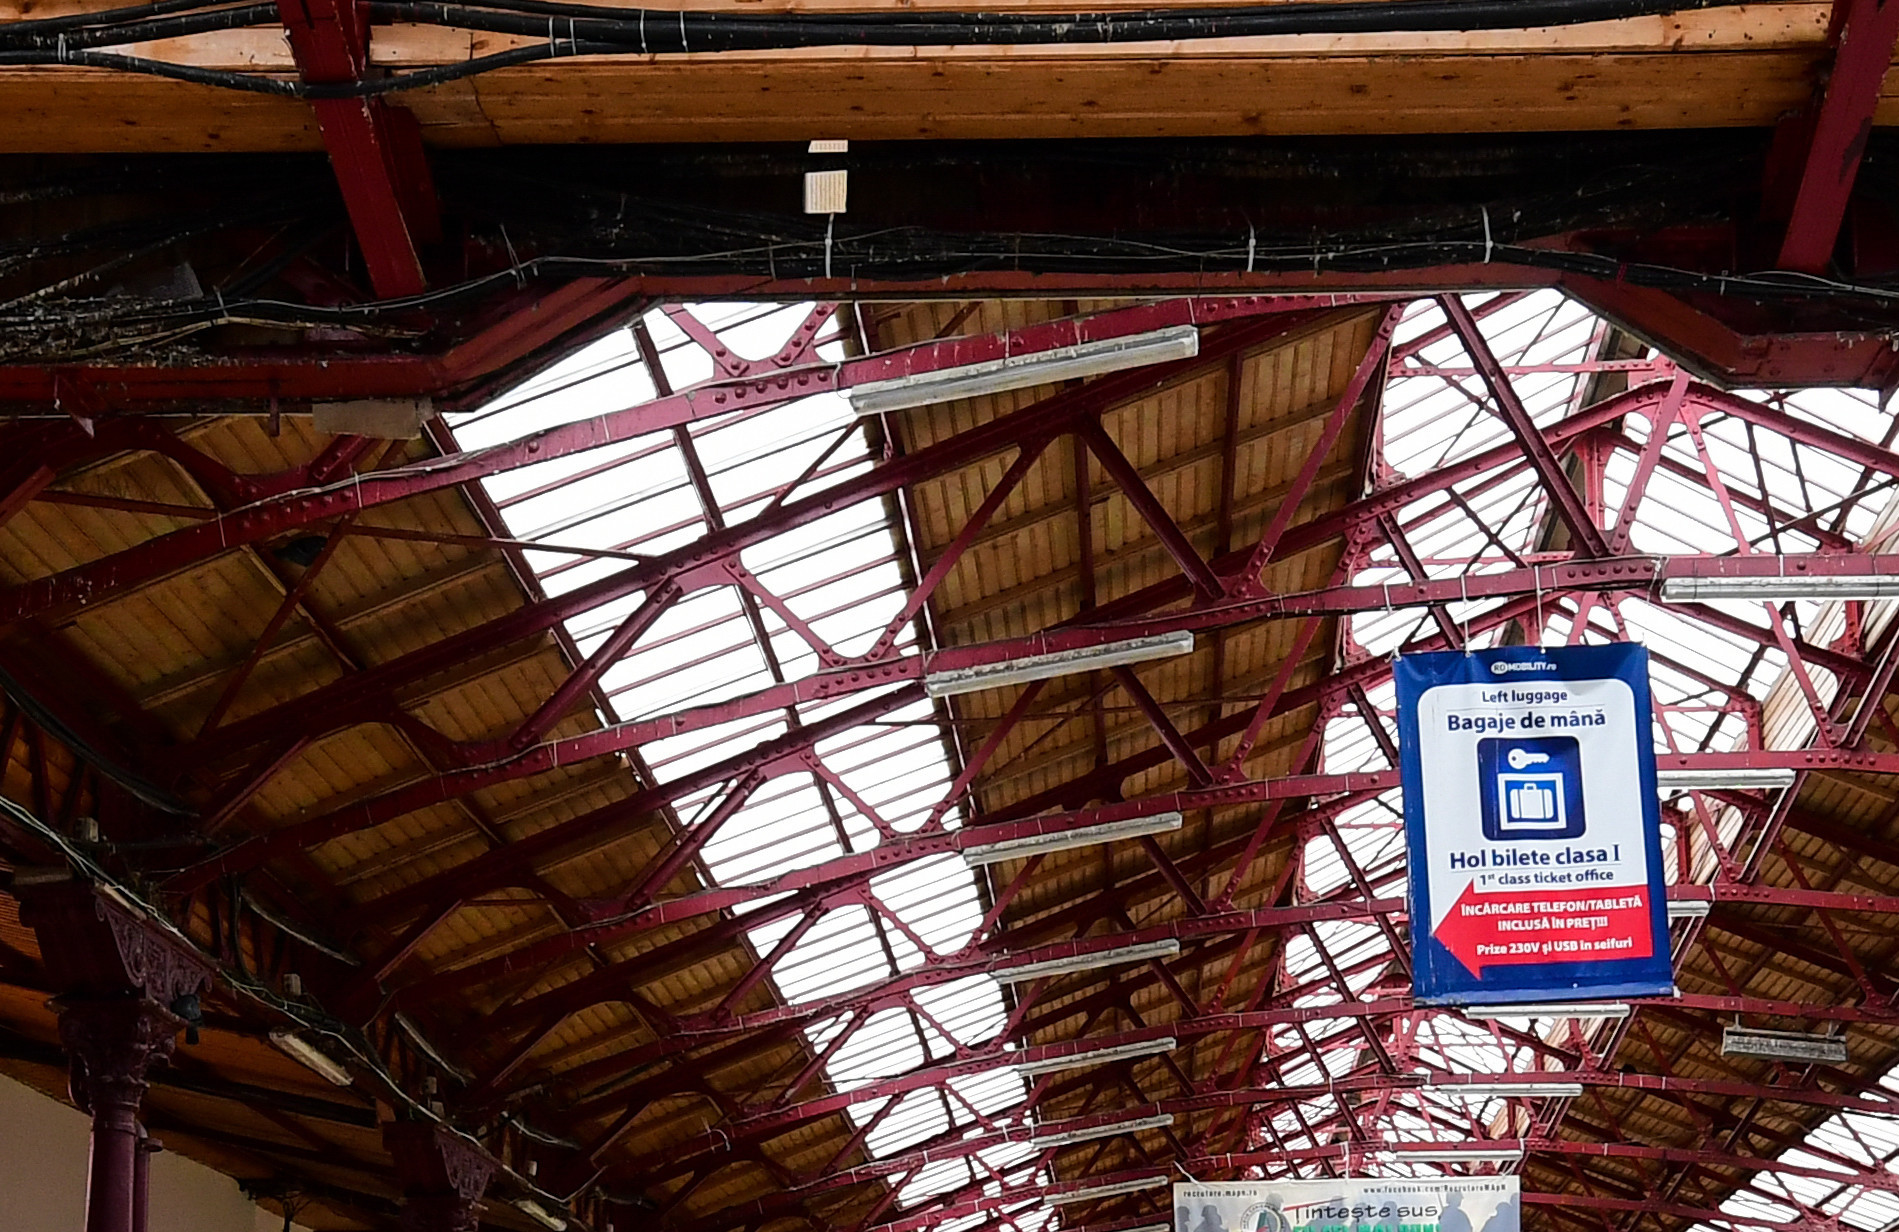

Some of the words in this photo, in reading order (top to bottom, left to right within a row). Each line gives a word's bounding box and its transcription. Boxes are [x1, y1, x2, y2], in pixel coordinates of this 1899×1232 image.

[1482, 690, 1508, 703] Left
[1512, 689, 1568, 703] luggage
[1448, 713, 1516, 733] Bagaje
[1520, 712, 1545, 728] de
[1550, 709, 1606, 727] mână
[1450, 849, 1487, 869] Hol
[1492, 847, 1550, 866] bilete
[1555, 846, 1608, 864] clasa
[1613, 844, 1621, 862] I
[1498, 872, 1531, 884] class
[1534, 870, 1572, 883] ticket
[1576, 869, 1614, 882] office
[1477, 944, 1507, 955] Prize
[1509, 942, 1540, 954] 230V
[1554, 940, 1578, 952] USB
[1594, 936, 1632, 949] seifuri
